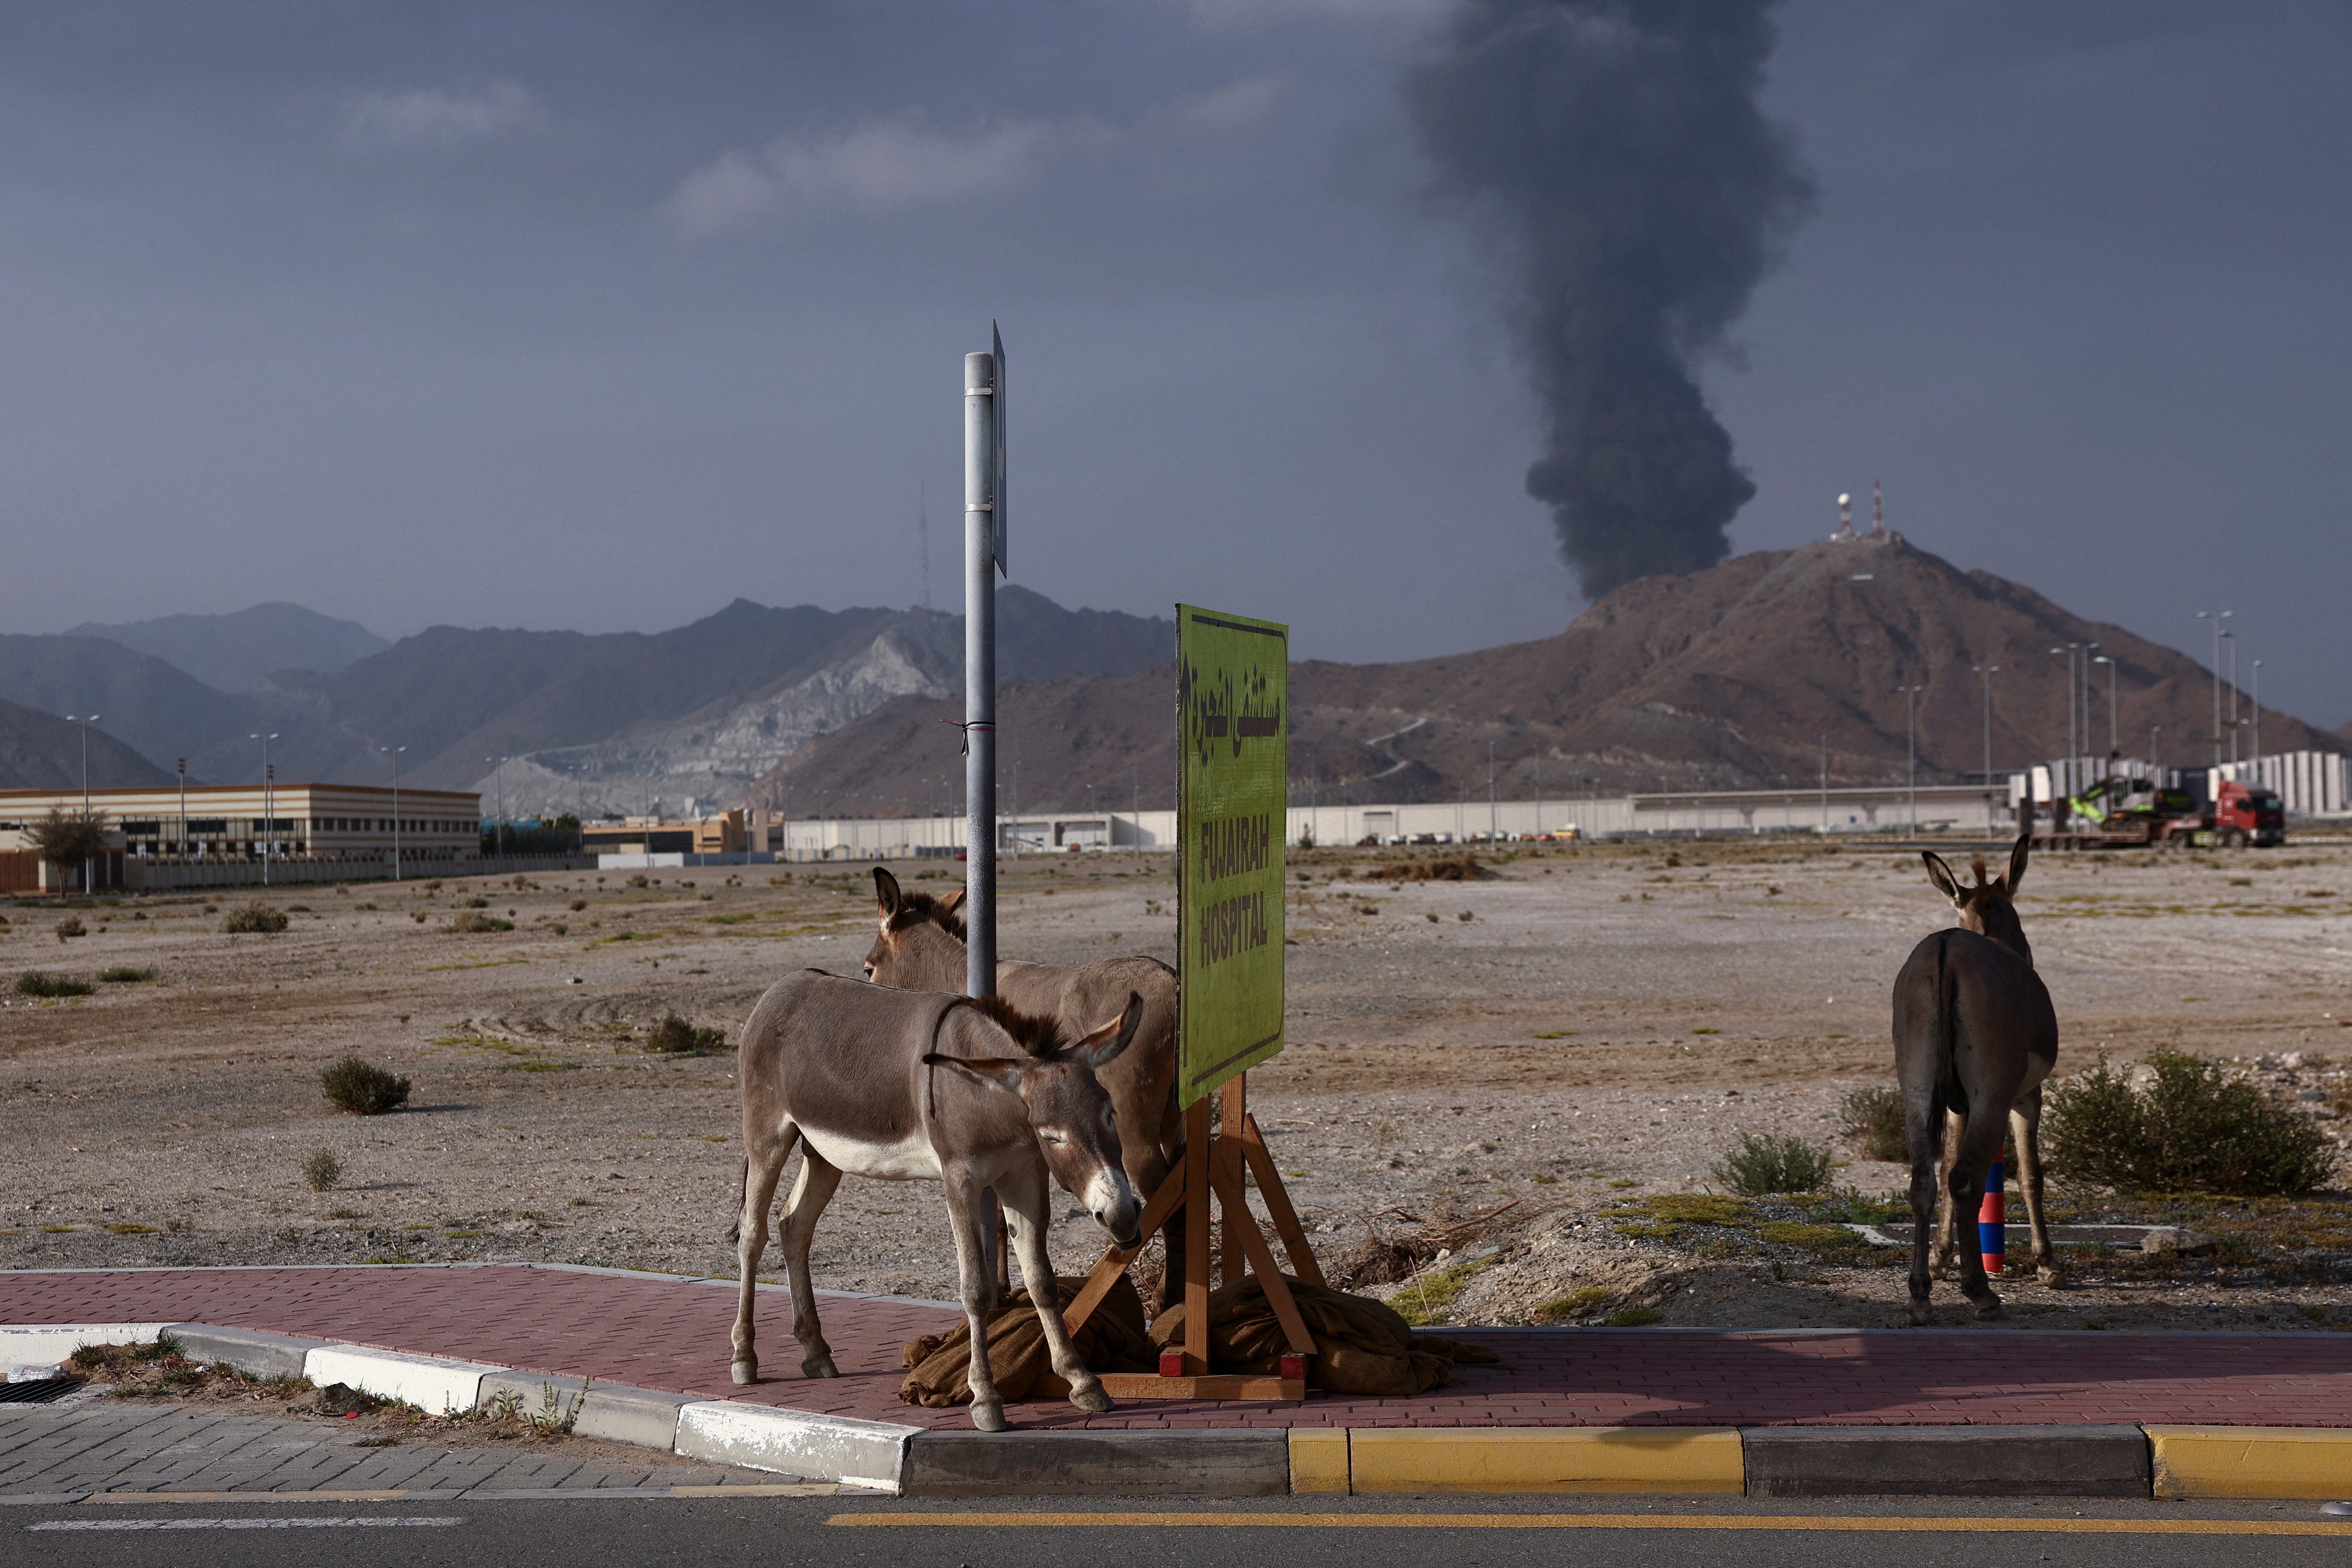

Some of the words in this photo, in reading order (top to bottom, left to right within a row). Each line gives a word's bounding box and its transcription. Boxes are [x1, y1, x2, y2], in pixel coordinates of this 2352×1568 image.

[1191, 666, 1233, 768] الفجيرة
[1233, 662, 1280, 758] مستشفى
[1201, 813, 1269, 883] FUJAIRAH
[1201, 891, 1267, 968] HOSPITAL
